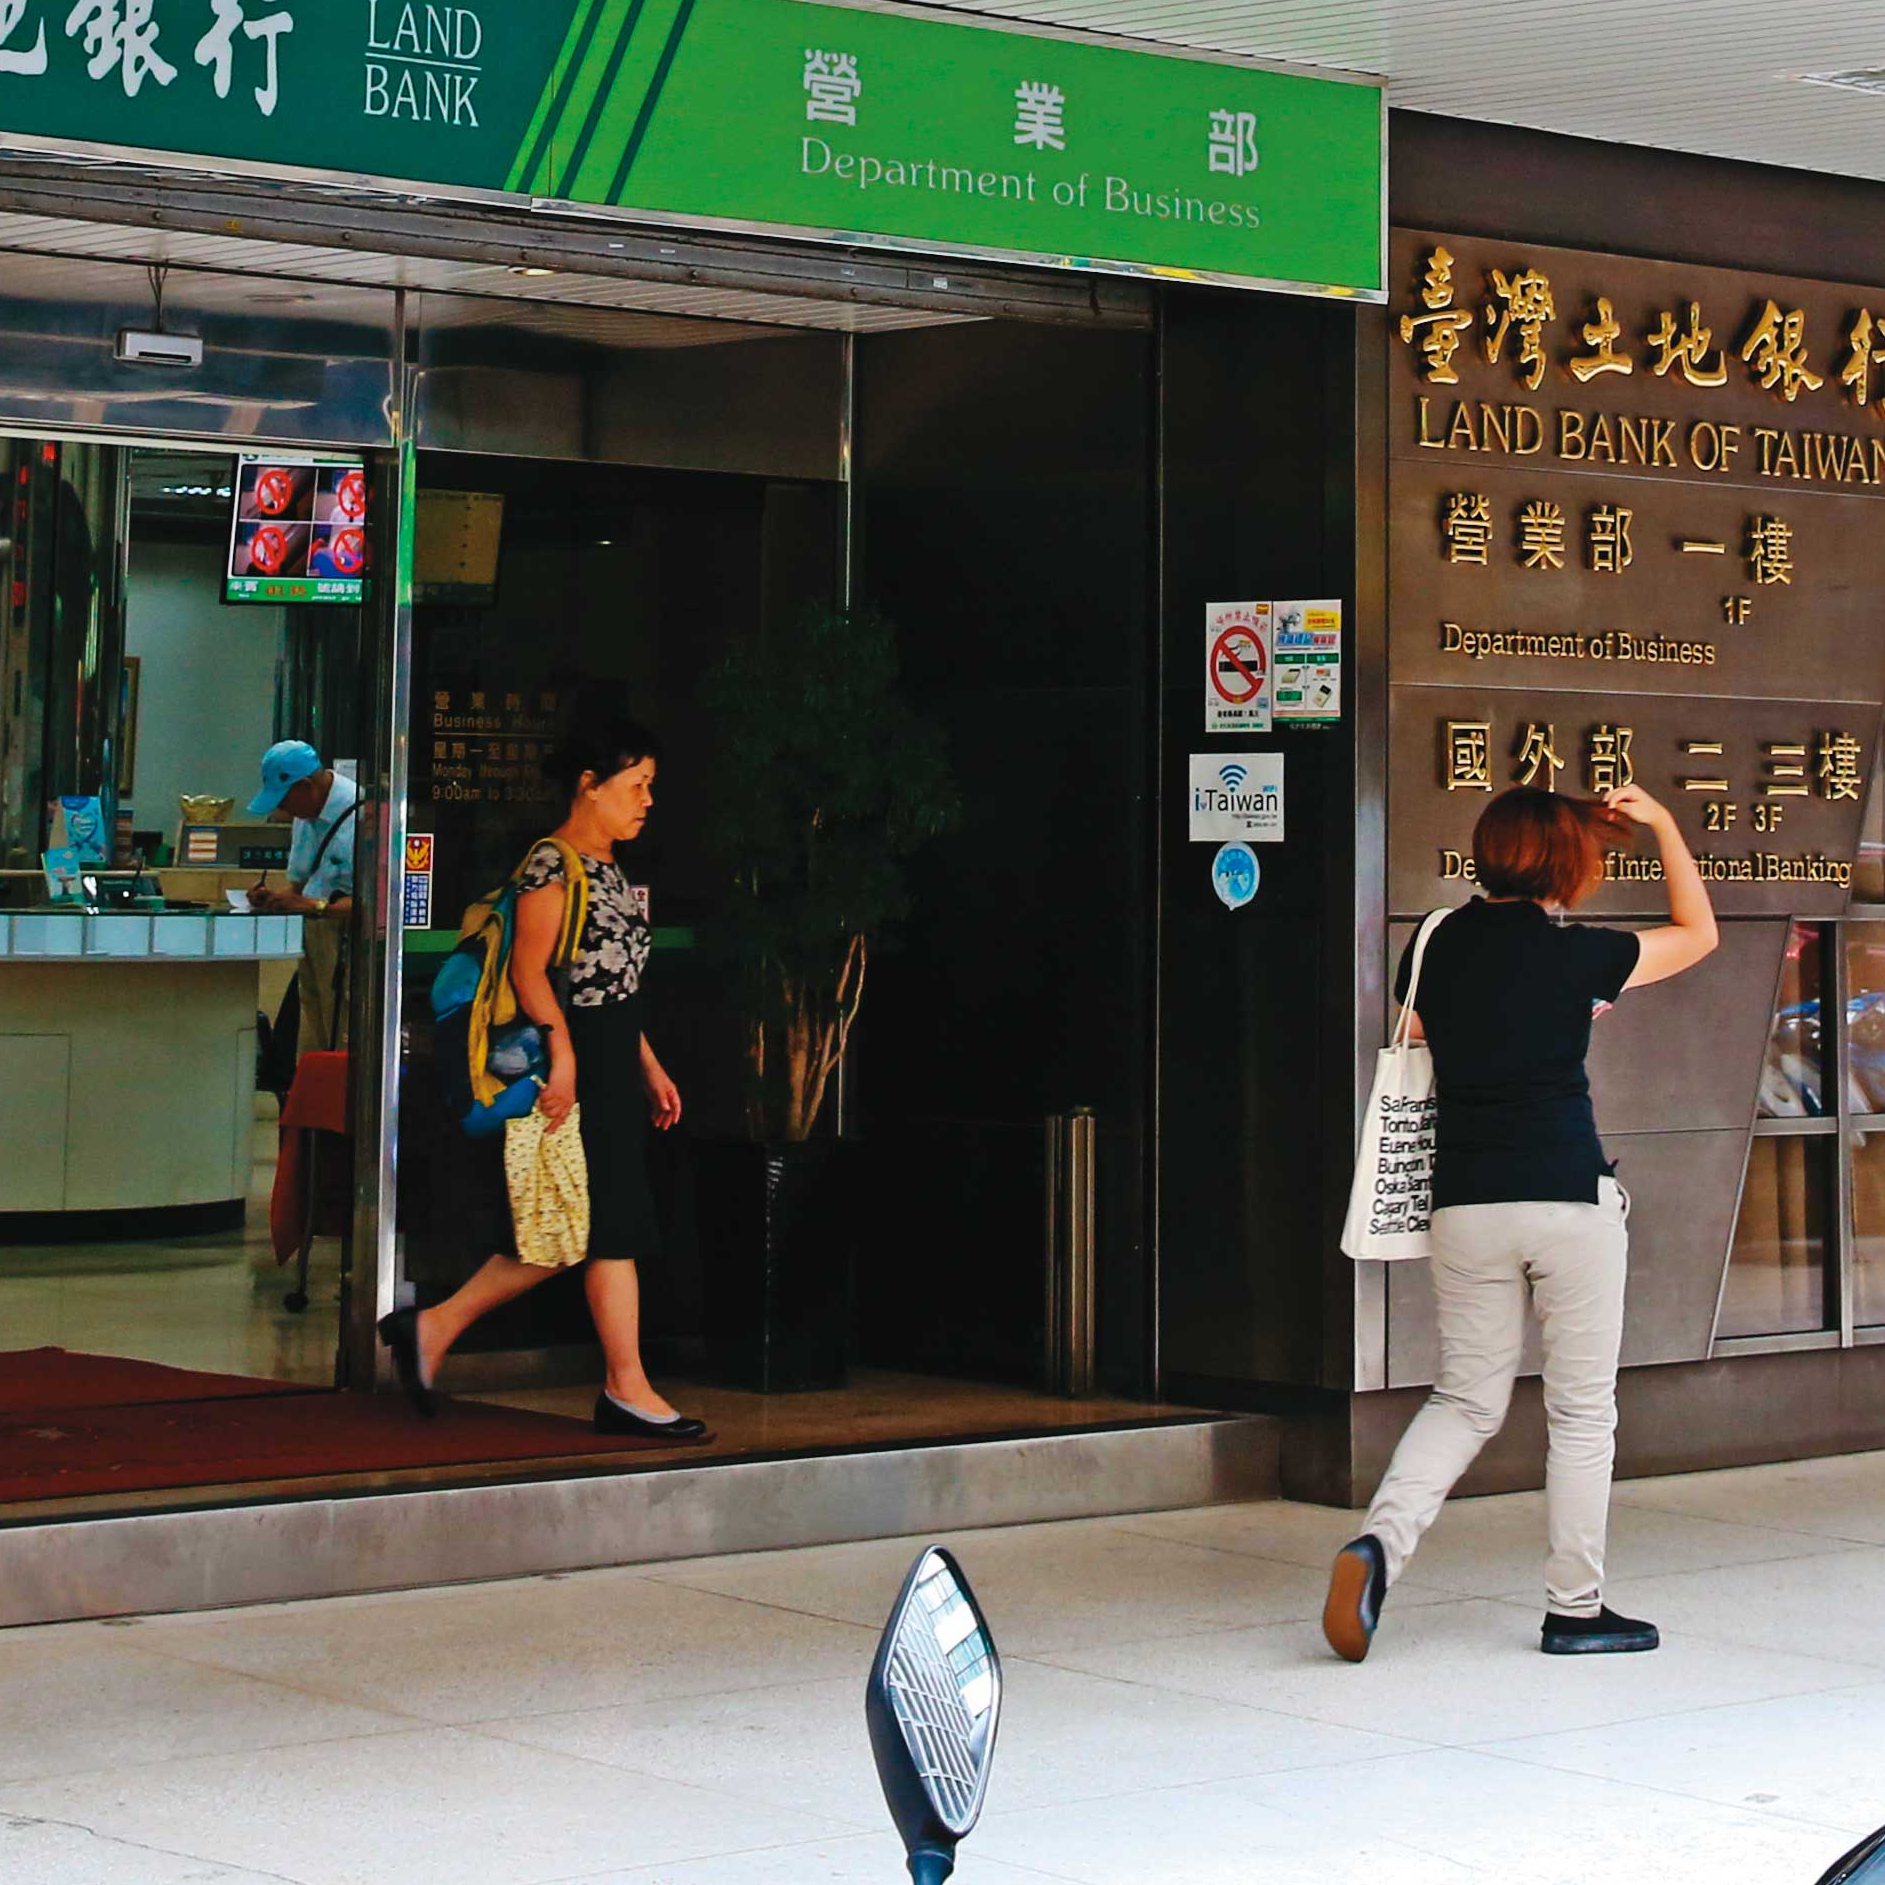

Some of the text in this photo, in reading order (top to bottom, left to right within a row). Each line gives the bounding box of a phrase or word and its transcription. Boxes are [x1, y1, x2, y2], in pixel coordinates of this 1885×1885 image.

[364, 63, 479, 128] BANK
[803, 48, 1259, 177] 營業部
[801, 136, 1261, 229] Department of Business
[1419, 396, 1544, 456] LAND
[1558, 410, 1678, 468] BANK
[1689, 421, 1741, 473] OF
[1447, 492, 1794, 585] 營業部 一樓
[1443, 623, 1716, 665] Department of Business
[1724, 598, 1753, 625] 1F
[433, 713, 501, 729] Business
[1445, 721, 1862, 801] 國外部 二三樓
[1706, 803, 1783, 833] 2F 3F
[1765, 854, 1853, 889] Banking
